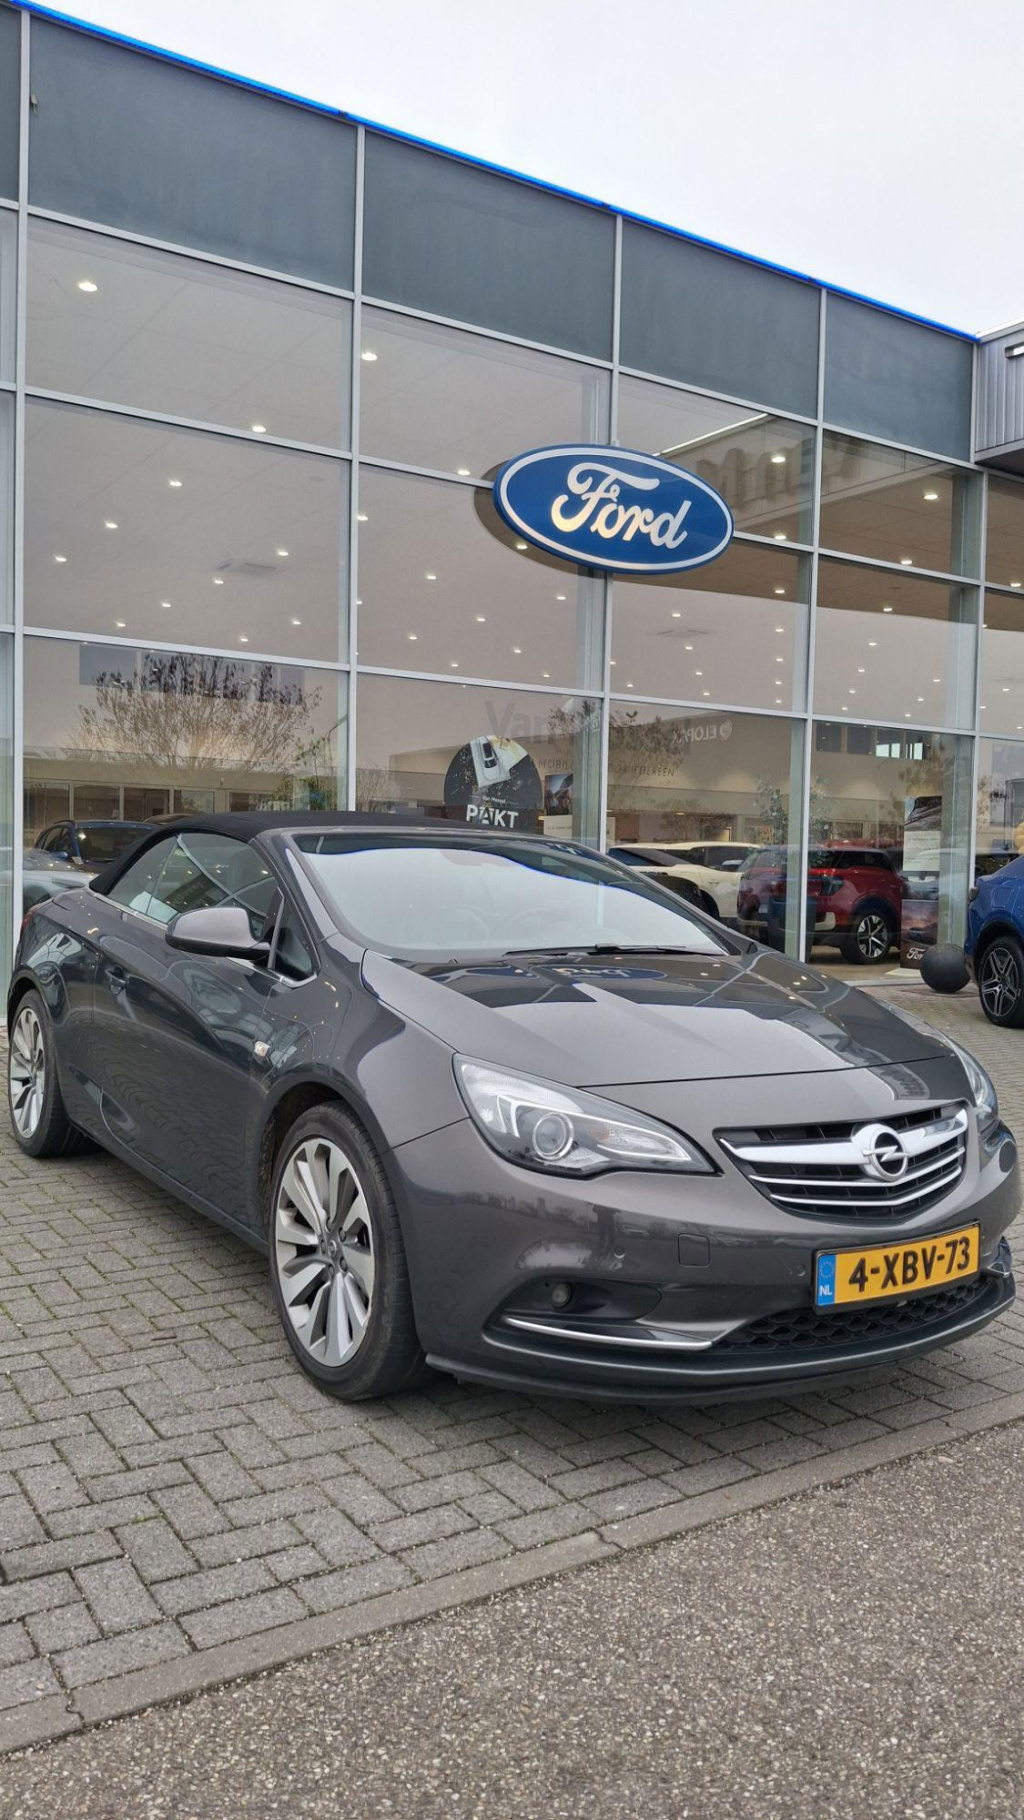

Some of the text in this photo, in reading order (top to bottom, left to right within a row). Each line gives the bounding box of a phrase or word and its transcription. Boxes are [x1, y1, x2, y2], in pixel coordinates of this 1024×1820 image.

[551, 462, 692, 549] Ford
[466, 804, 519, 828] PAKT
[906, 947, 926, 959] For
[849, 1236, 971, 1292] 4-XBV-73
[819, 1285, 833, 1296] NL
